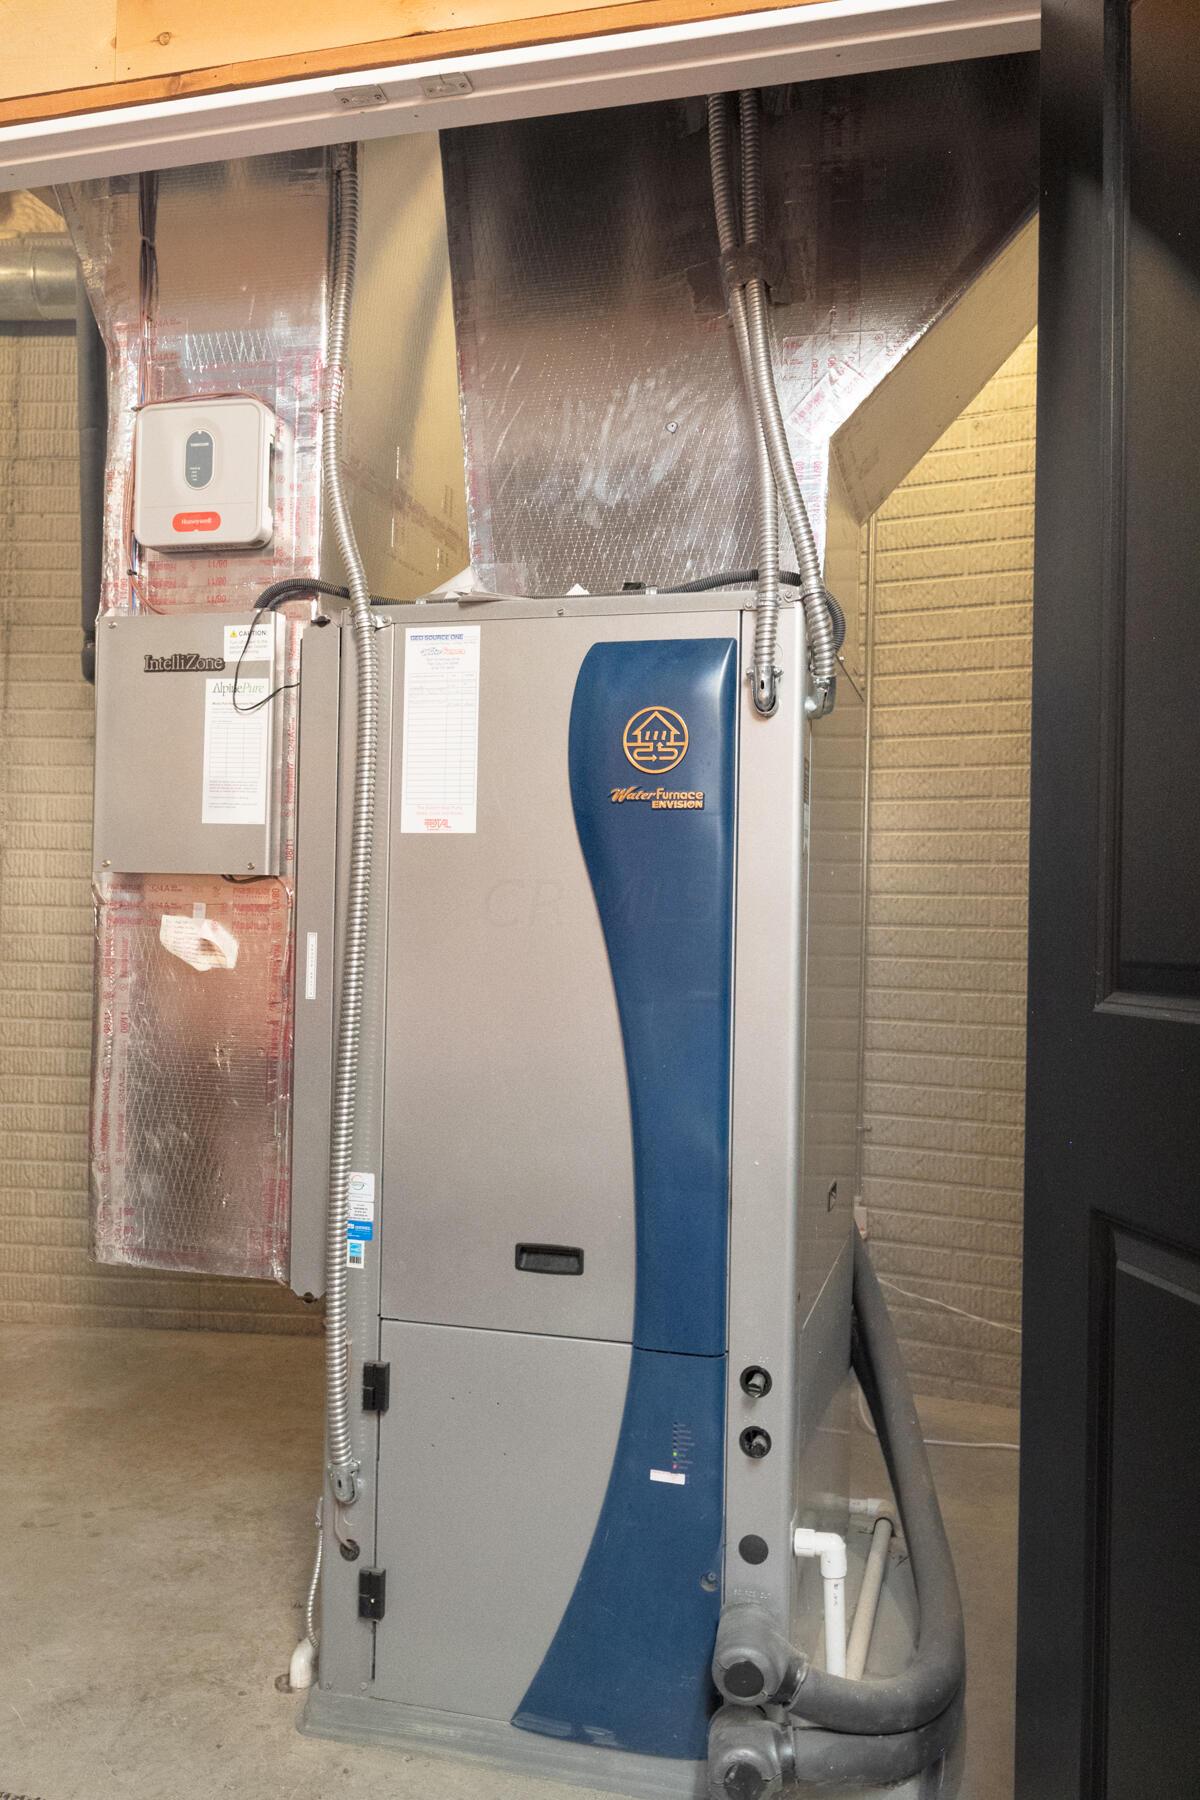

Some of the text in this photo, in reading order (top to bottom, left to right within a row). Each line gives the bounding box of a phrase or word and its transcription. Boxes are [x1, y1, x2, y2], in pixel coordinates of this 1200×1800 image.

[181, 517, 212, 526] Honeywell
[143, 653, 225, 672] IntelliZone
[651, 799, 704, 809] ENVISION
